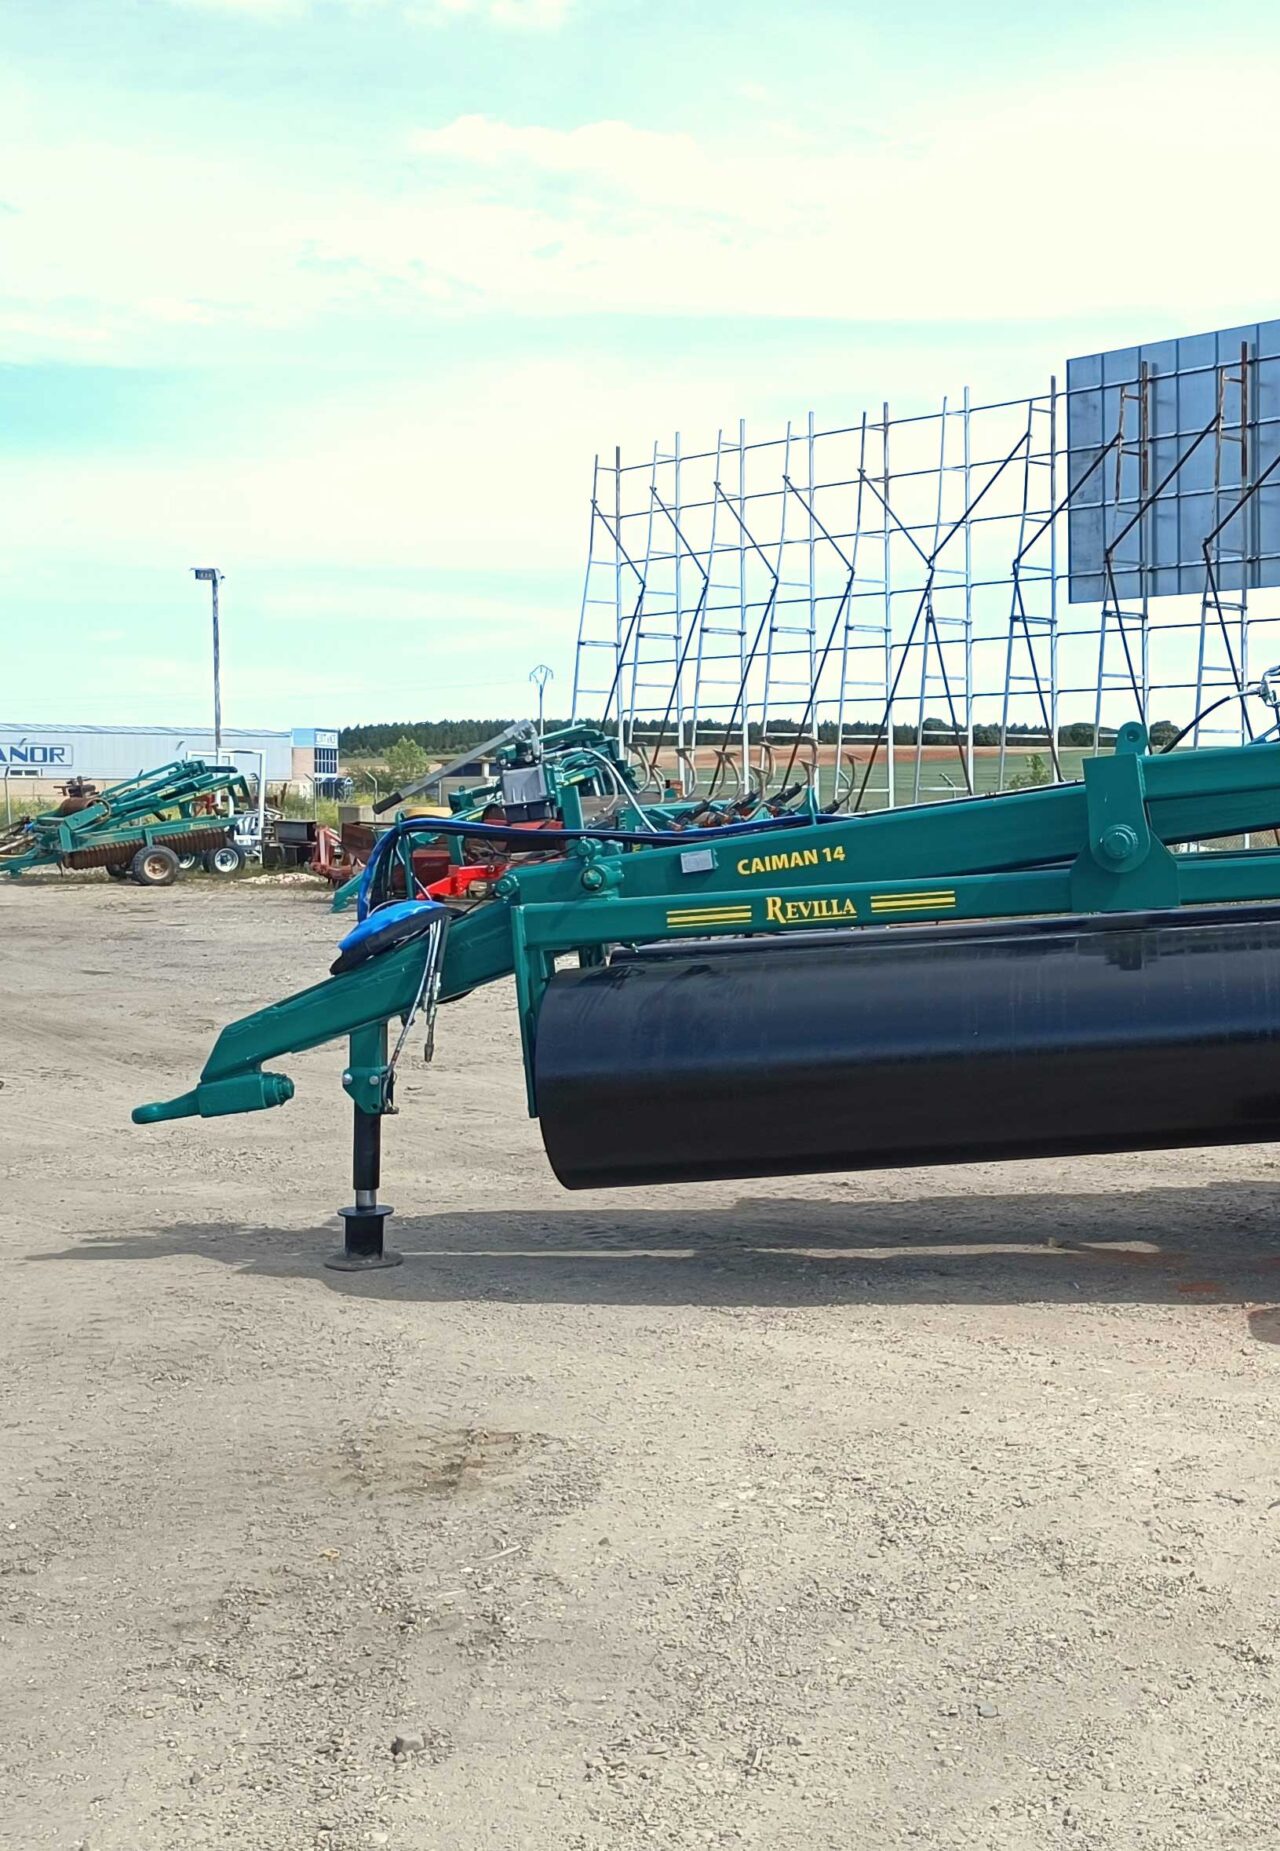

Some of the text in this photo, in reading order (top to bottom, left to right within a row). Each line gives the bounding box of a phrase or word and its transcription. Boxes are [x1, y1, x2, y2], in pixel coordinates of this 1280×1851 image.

[737, 849, 819, 875] CAIMAN
[822, 846, 846, 862] 14
[766, 896, 858, 924] REVILLA
